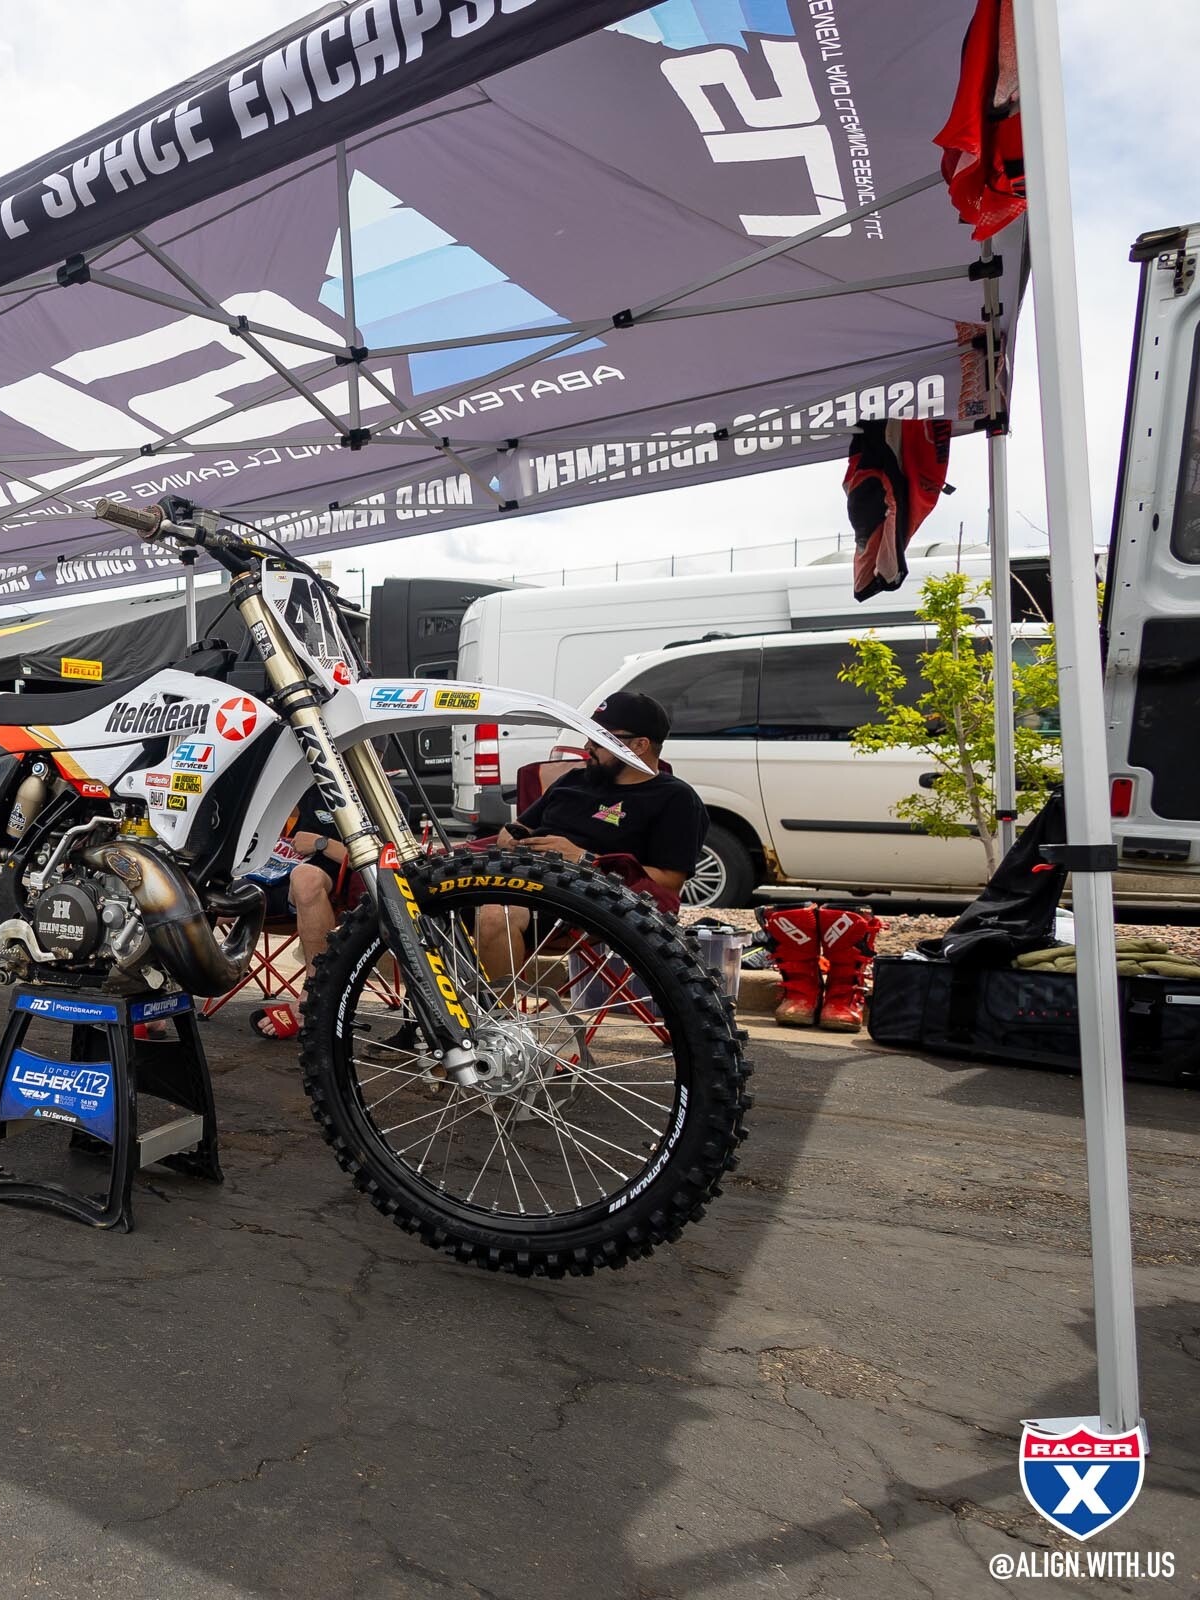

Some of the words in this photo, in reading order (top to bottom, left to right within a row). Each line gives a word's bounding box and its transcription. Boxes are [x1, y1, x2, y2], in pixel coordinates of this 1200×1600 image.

[41, 100, 214, 218] SPACE
[228, 0, 538, 140] ENCAPS
[63, 661, 101, 677] PIRELLI
[371, 685, 425, 703] SLJ
[450, 692, 476, 700] BUDGET
[376, 701, 419, 709] Services
[447, 699, 477, 708] BLINDS
[172, 745, 213, 762] SLJ
[175, 761, 209, 769] Services
[82, 783, 104, 793] FCP
[439, 876, 545, 894] DUNLOP
[39, 921, 84, 935] HINSON
[393, 872, 471, 1030] DULOP
[349, 938, 381, 984] PLATINUM
[56, 1004, 103, 1016] PHOTOGRAPHY
[11, 1065, 74, 1092] LESHER
[73, 1069, 110, 1098] 412
[629, 1148, 670, 1200] PLATINUM
